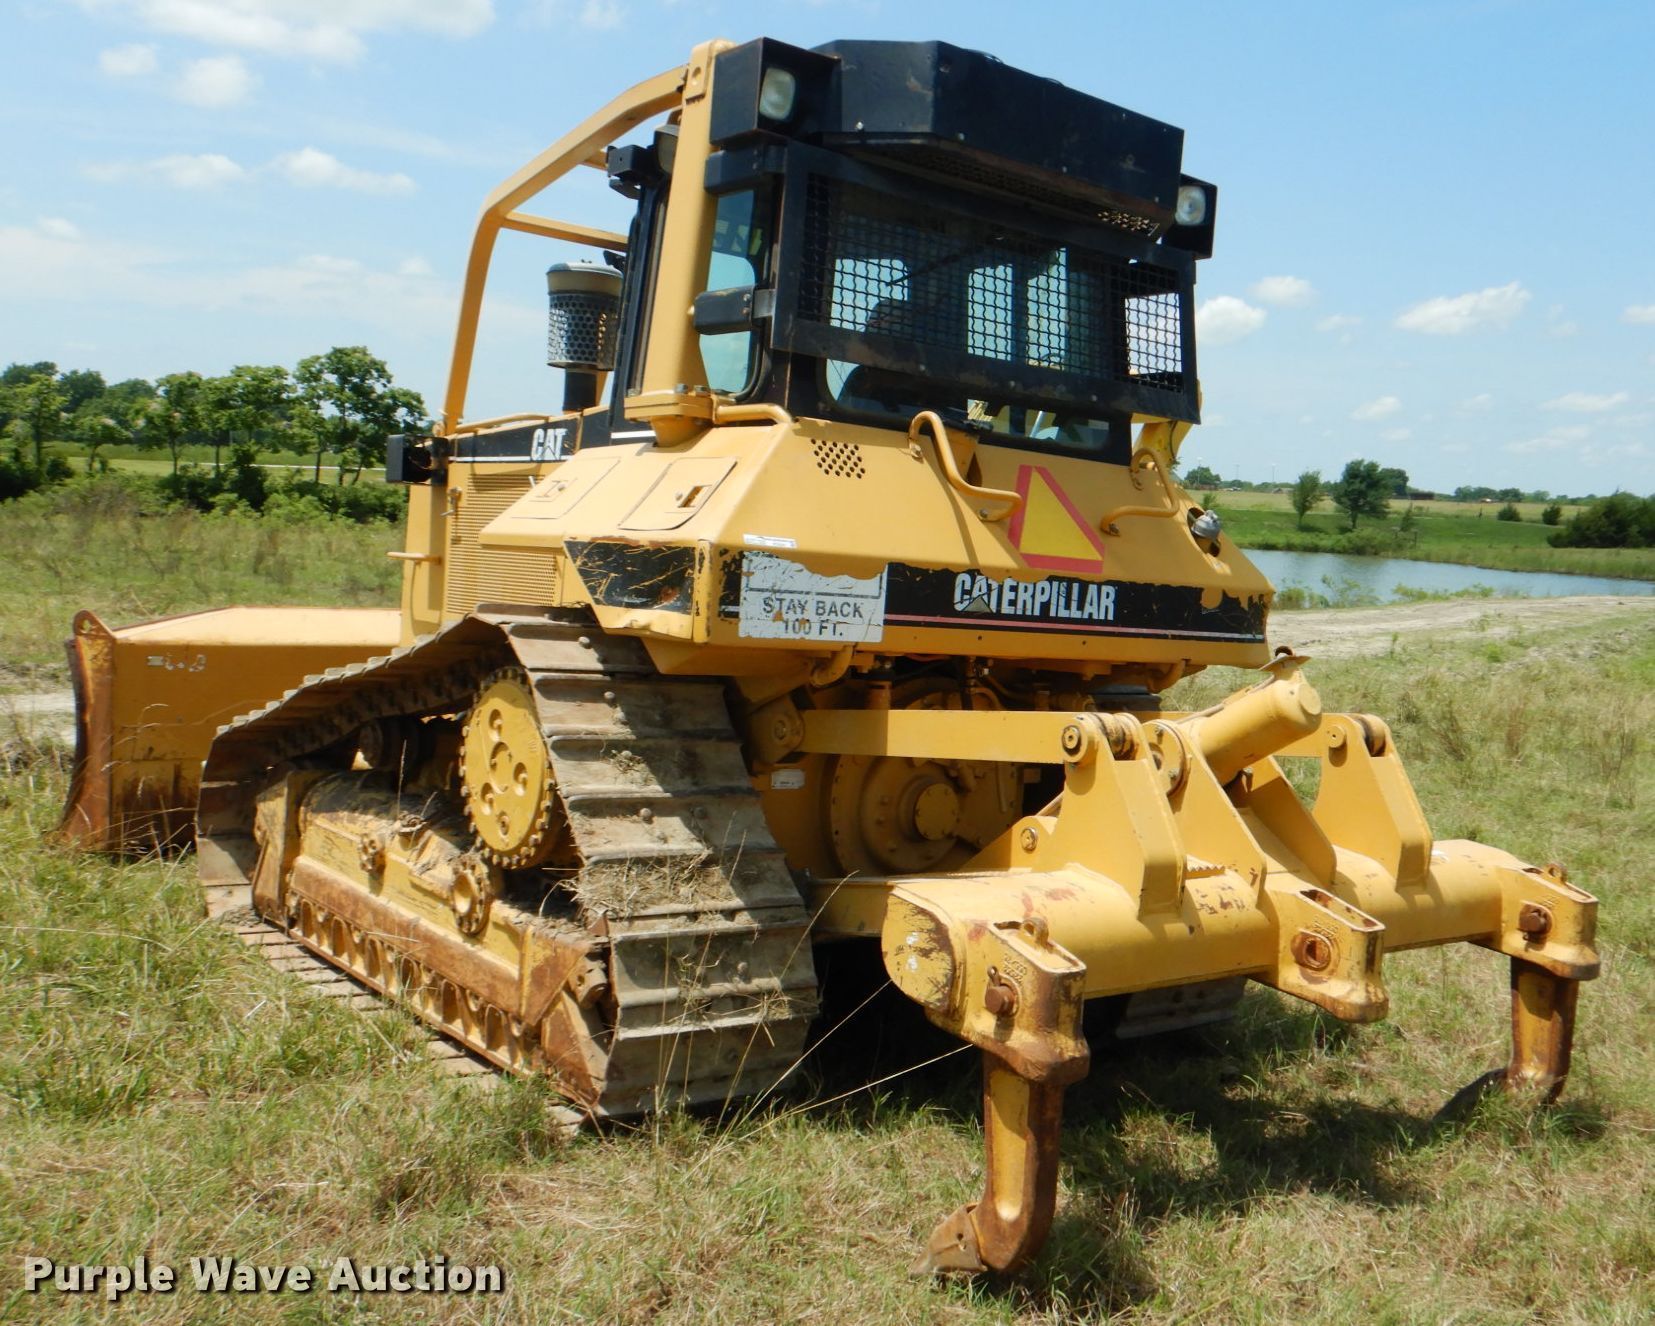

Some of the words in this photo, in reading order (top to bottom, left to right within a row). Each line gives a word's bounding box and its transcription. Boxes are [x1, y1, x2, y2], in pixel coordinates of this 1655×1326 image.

[531, 428, 568, 461] CAT
[763, 596, 808, 615] STAY
[815, 600, 863, 619] BACK
[953, 573, 1116, 621] CATERPILLAR
[784, 617, 811, 635] 100
